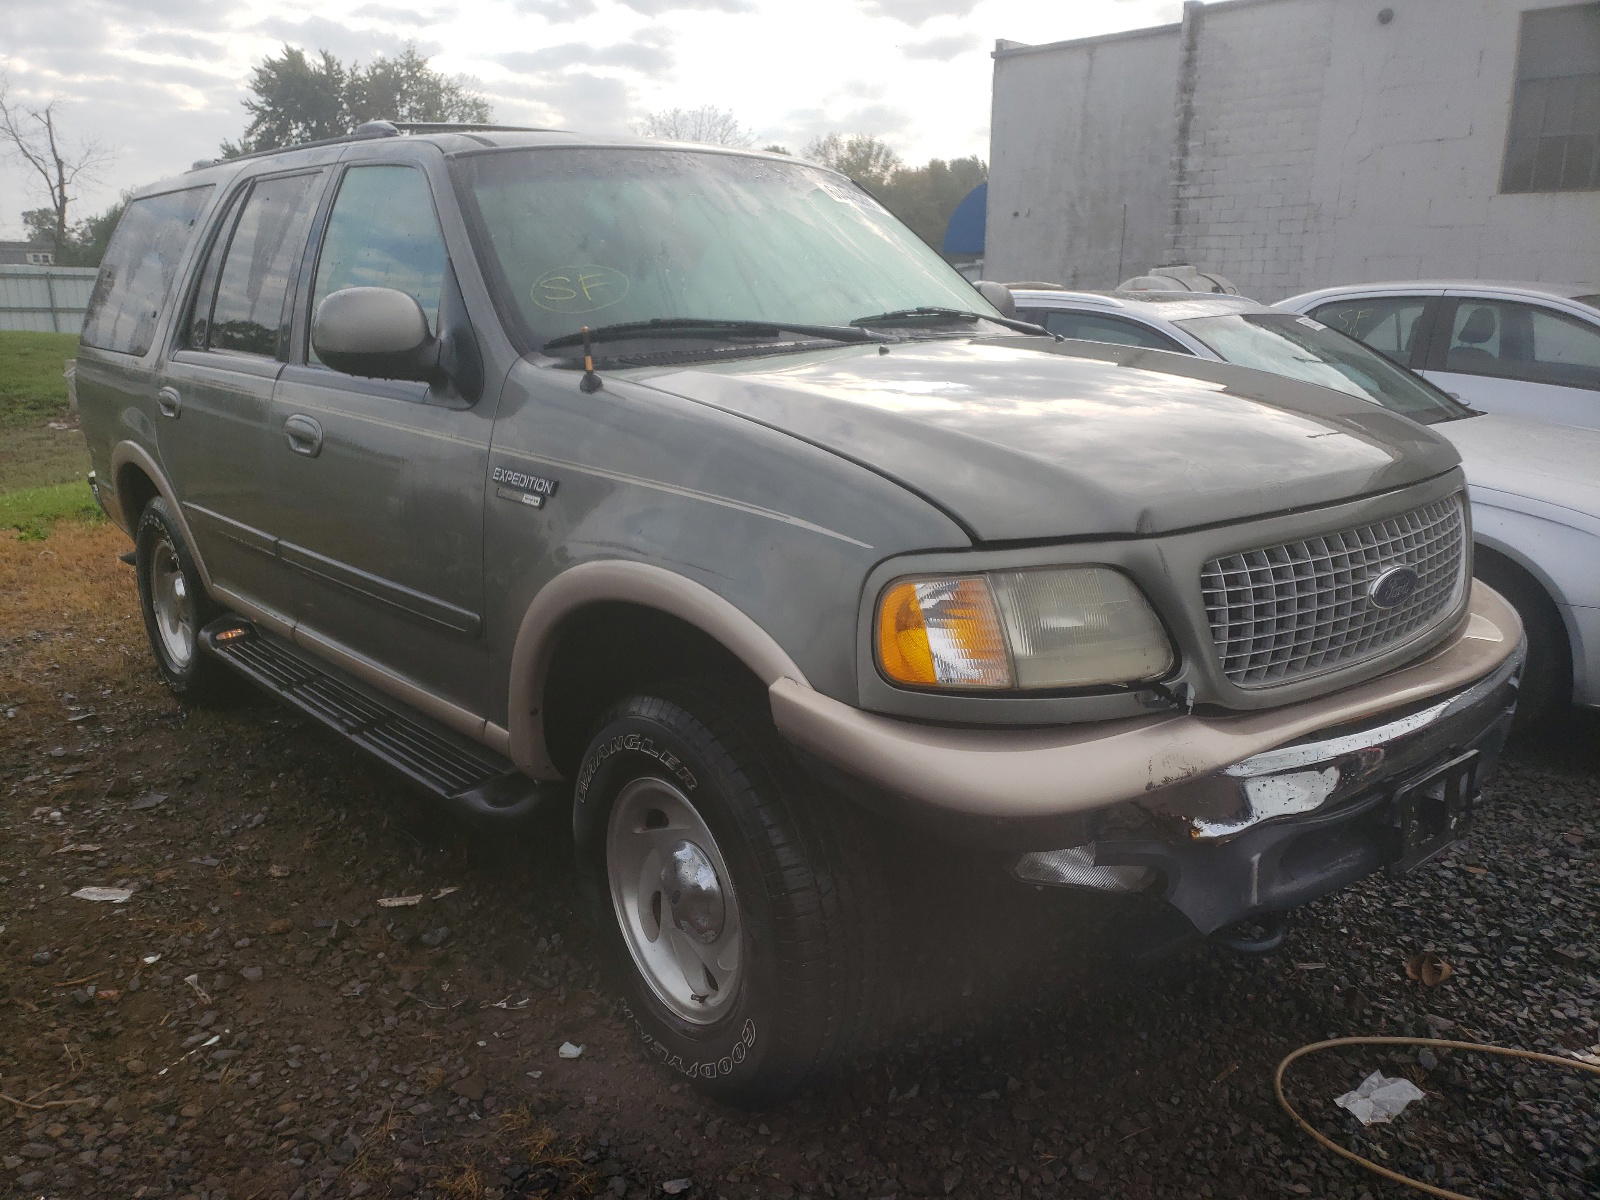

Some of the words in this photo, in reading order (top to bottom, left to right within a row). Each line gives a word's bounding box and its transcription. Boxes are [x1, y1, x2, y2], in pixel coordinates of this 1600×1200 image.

[540, 273, 612, 301] SF
[492, 467, 554, 494] EXPEDITION
[577, 733, 698, 804] WRANGLER
